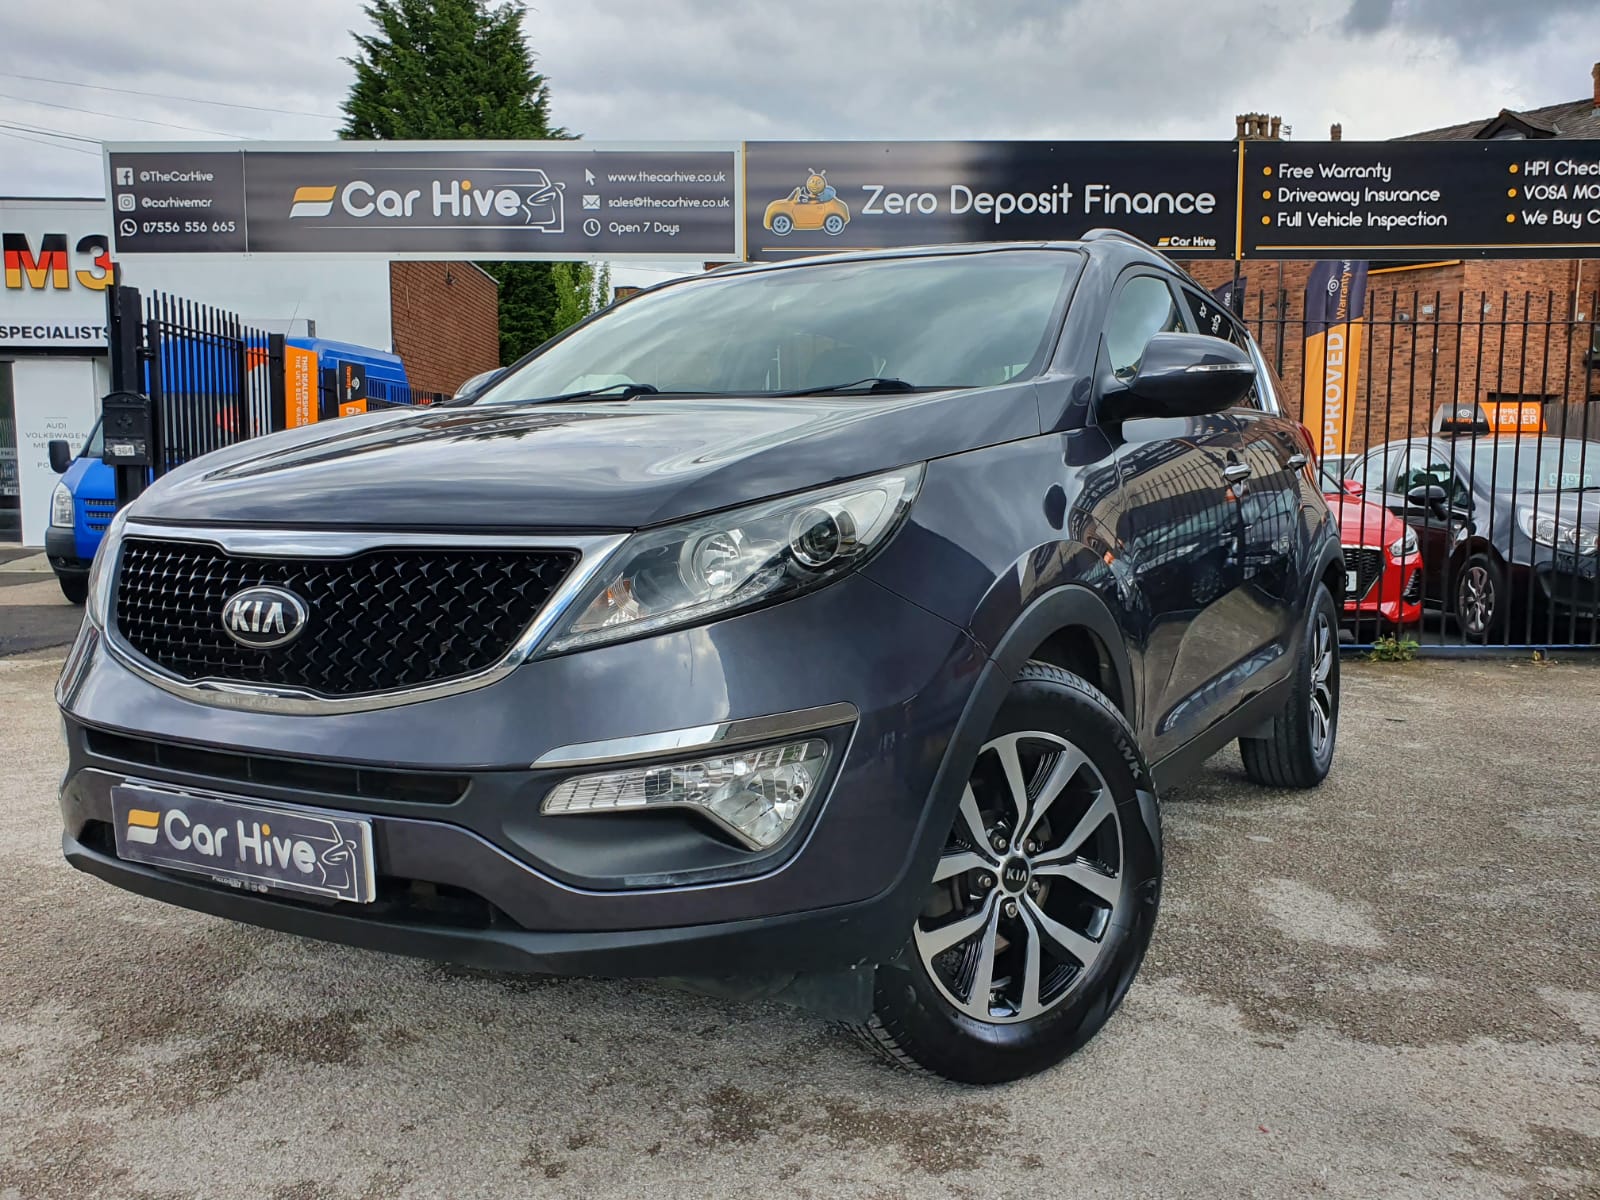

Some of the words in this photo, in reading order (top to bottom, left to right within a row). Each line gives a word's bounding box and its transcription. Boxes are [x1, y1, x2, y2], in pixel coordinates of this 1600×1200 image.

[1278, 163, 1314, 178] Free
[1319, 162, 1392, 183] Warranty
[1524, 161, 1550, 176] HPI
[140, 171, 214, 182] @TheCarHive
[607, 171, 726, 182] www.thecarhive.co.uk
[341, 180, 421, 217] Car
[432, 180, 521, 217] Hive
[1278, 187, 1360, 207] Driveaway
[1364, 187, 1441, 202] Insurance
[1523, 185, 1568, 200] VOSA
[141, 196, 213, 208] @carhivemcr
[608, 196, 730, 208] sales@thecarhive.co.uk
[861, 185, 938, 214] Zero
[950, 182, 1073, 224] Deposit
[1084, 184, 1216, 214] Finance
[143, 222, 180, 233] 07556
[184, 222, 208, 233] 556
[211, 221, 236, 233] 665
[1277, 211, 1302, 227] Full
[1306, 211, 1363, 227] Vehicle
[1367, 210, 1448, 231] Inspection
[1521, 210, 1548, 225] We
[1553, 210, 1582, 229] Buy
[608, 222, 640, 235] Open
[643, 222, 651, 232] 7
[654, 222, 680, 235] Days
[1170, 237, 1191, 247] Car
[1193, 236, 1216, 247] Hive
[46, 422, 67, 430] AUDI
[231, 600, 286, 634] KIA
[164, 809, 228, 857] Car
[237, 820, 316, 873] Hive
[1006, 868, 1027, 882] KIA
